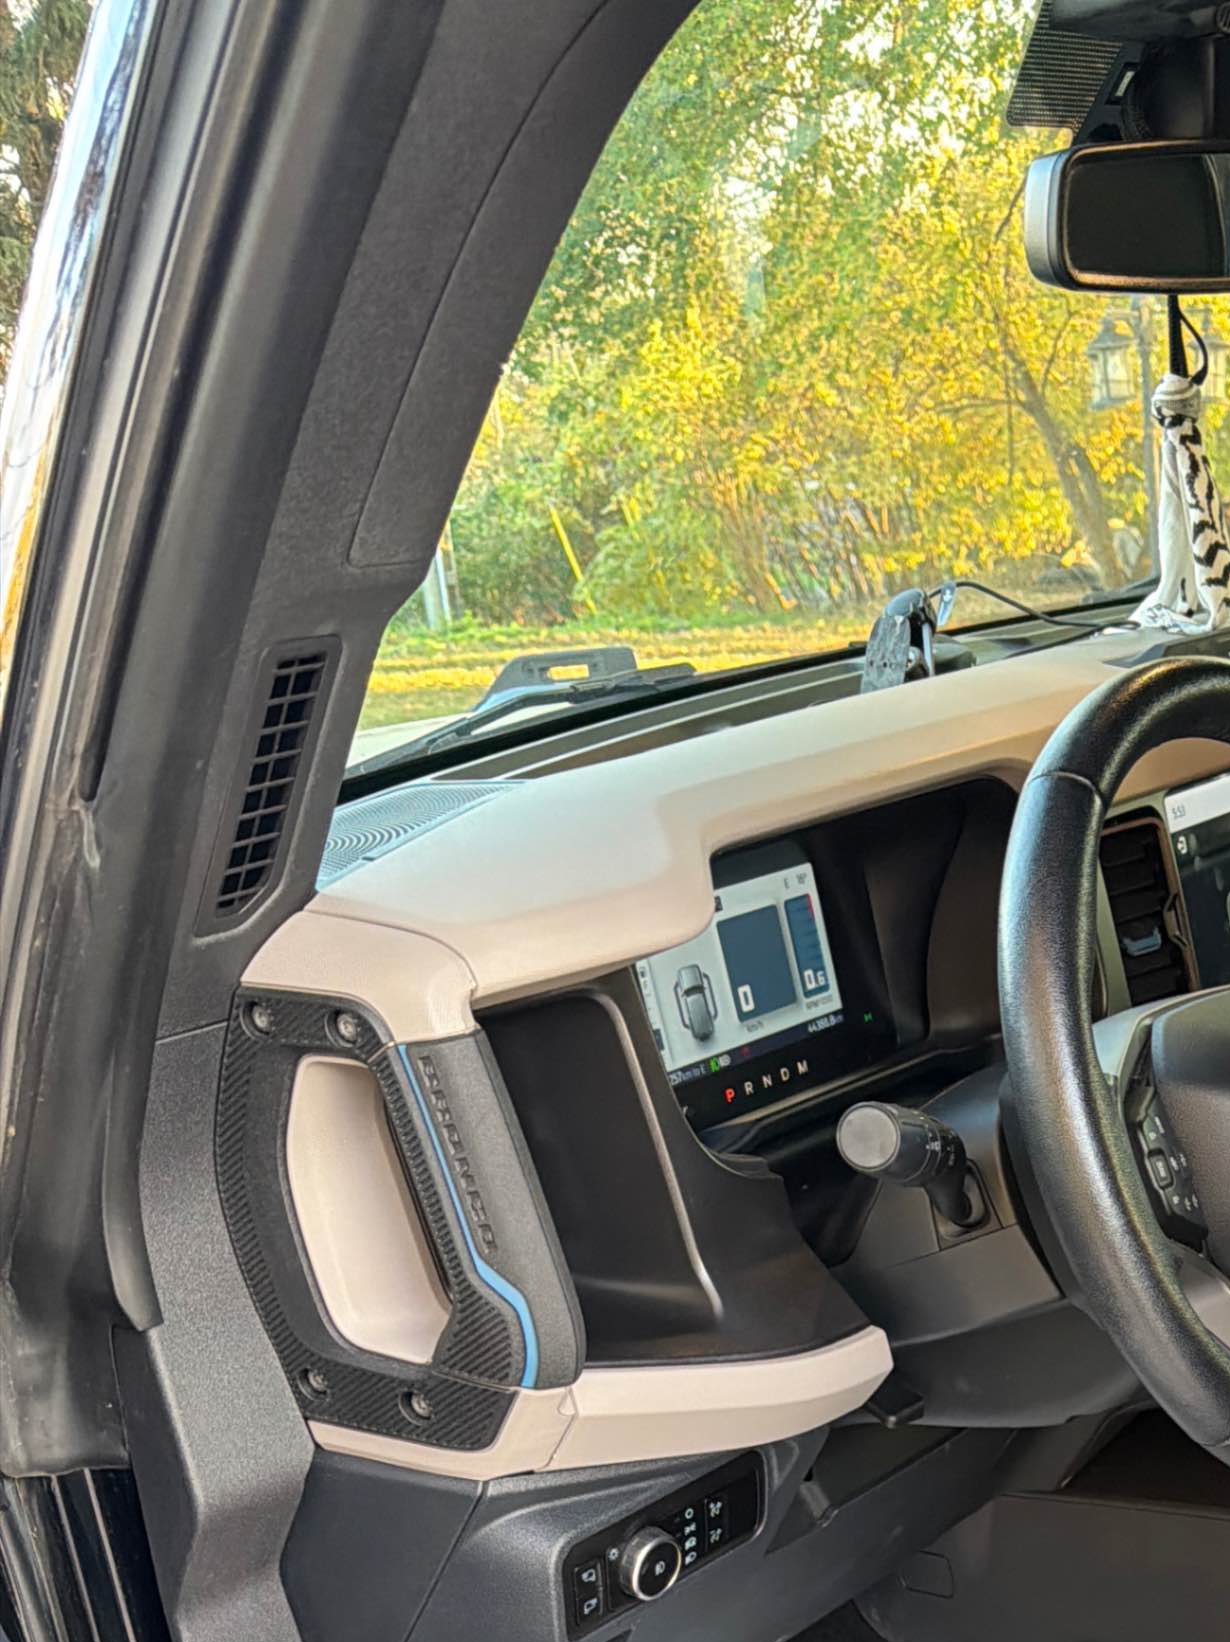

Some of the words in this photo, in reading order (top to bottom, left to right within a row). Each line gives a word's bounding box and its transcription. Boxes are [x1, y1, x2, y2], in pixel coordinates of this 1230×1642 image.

[737, 983, 755, 1013] 0
[724, 1087, 735, 1103] P
[744, 1081, 754, 1096] R
[762, 1074, 773, 1089] N
[780, 1067, 790, 1082] D
[796, 1060, 809, 1075] M
[417, 1055, 499, 1255] BRONCO
